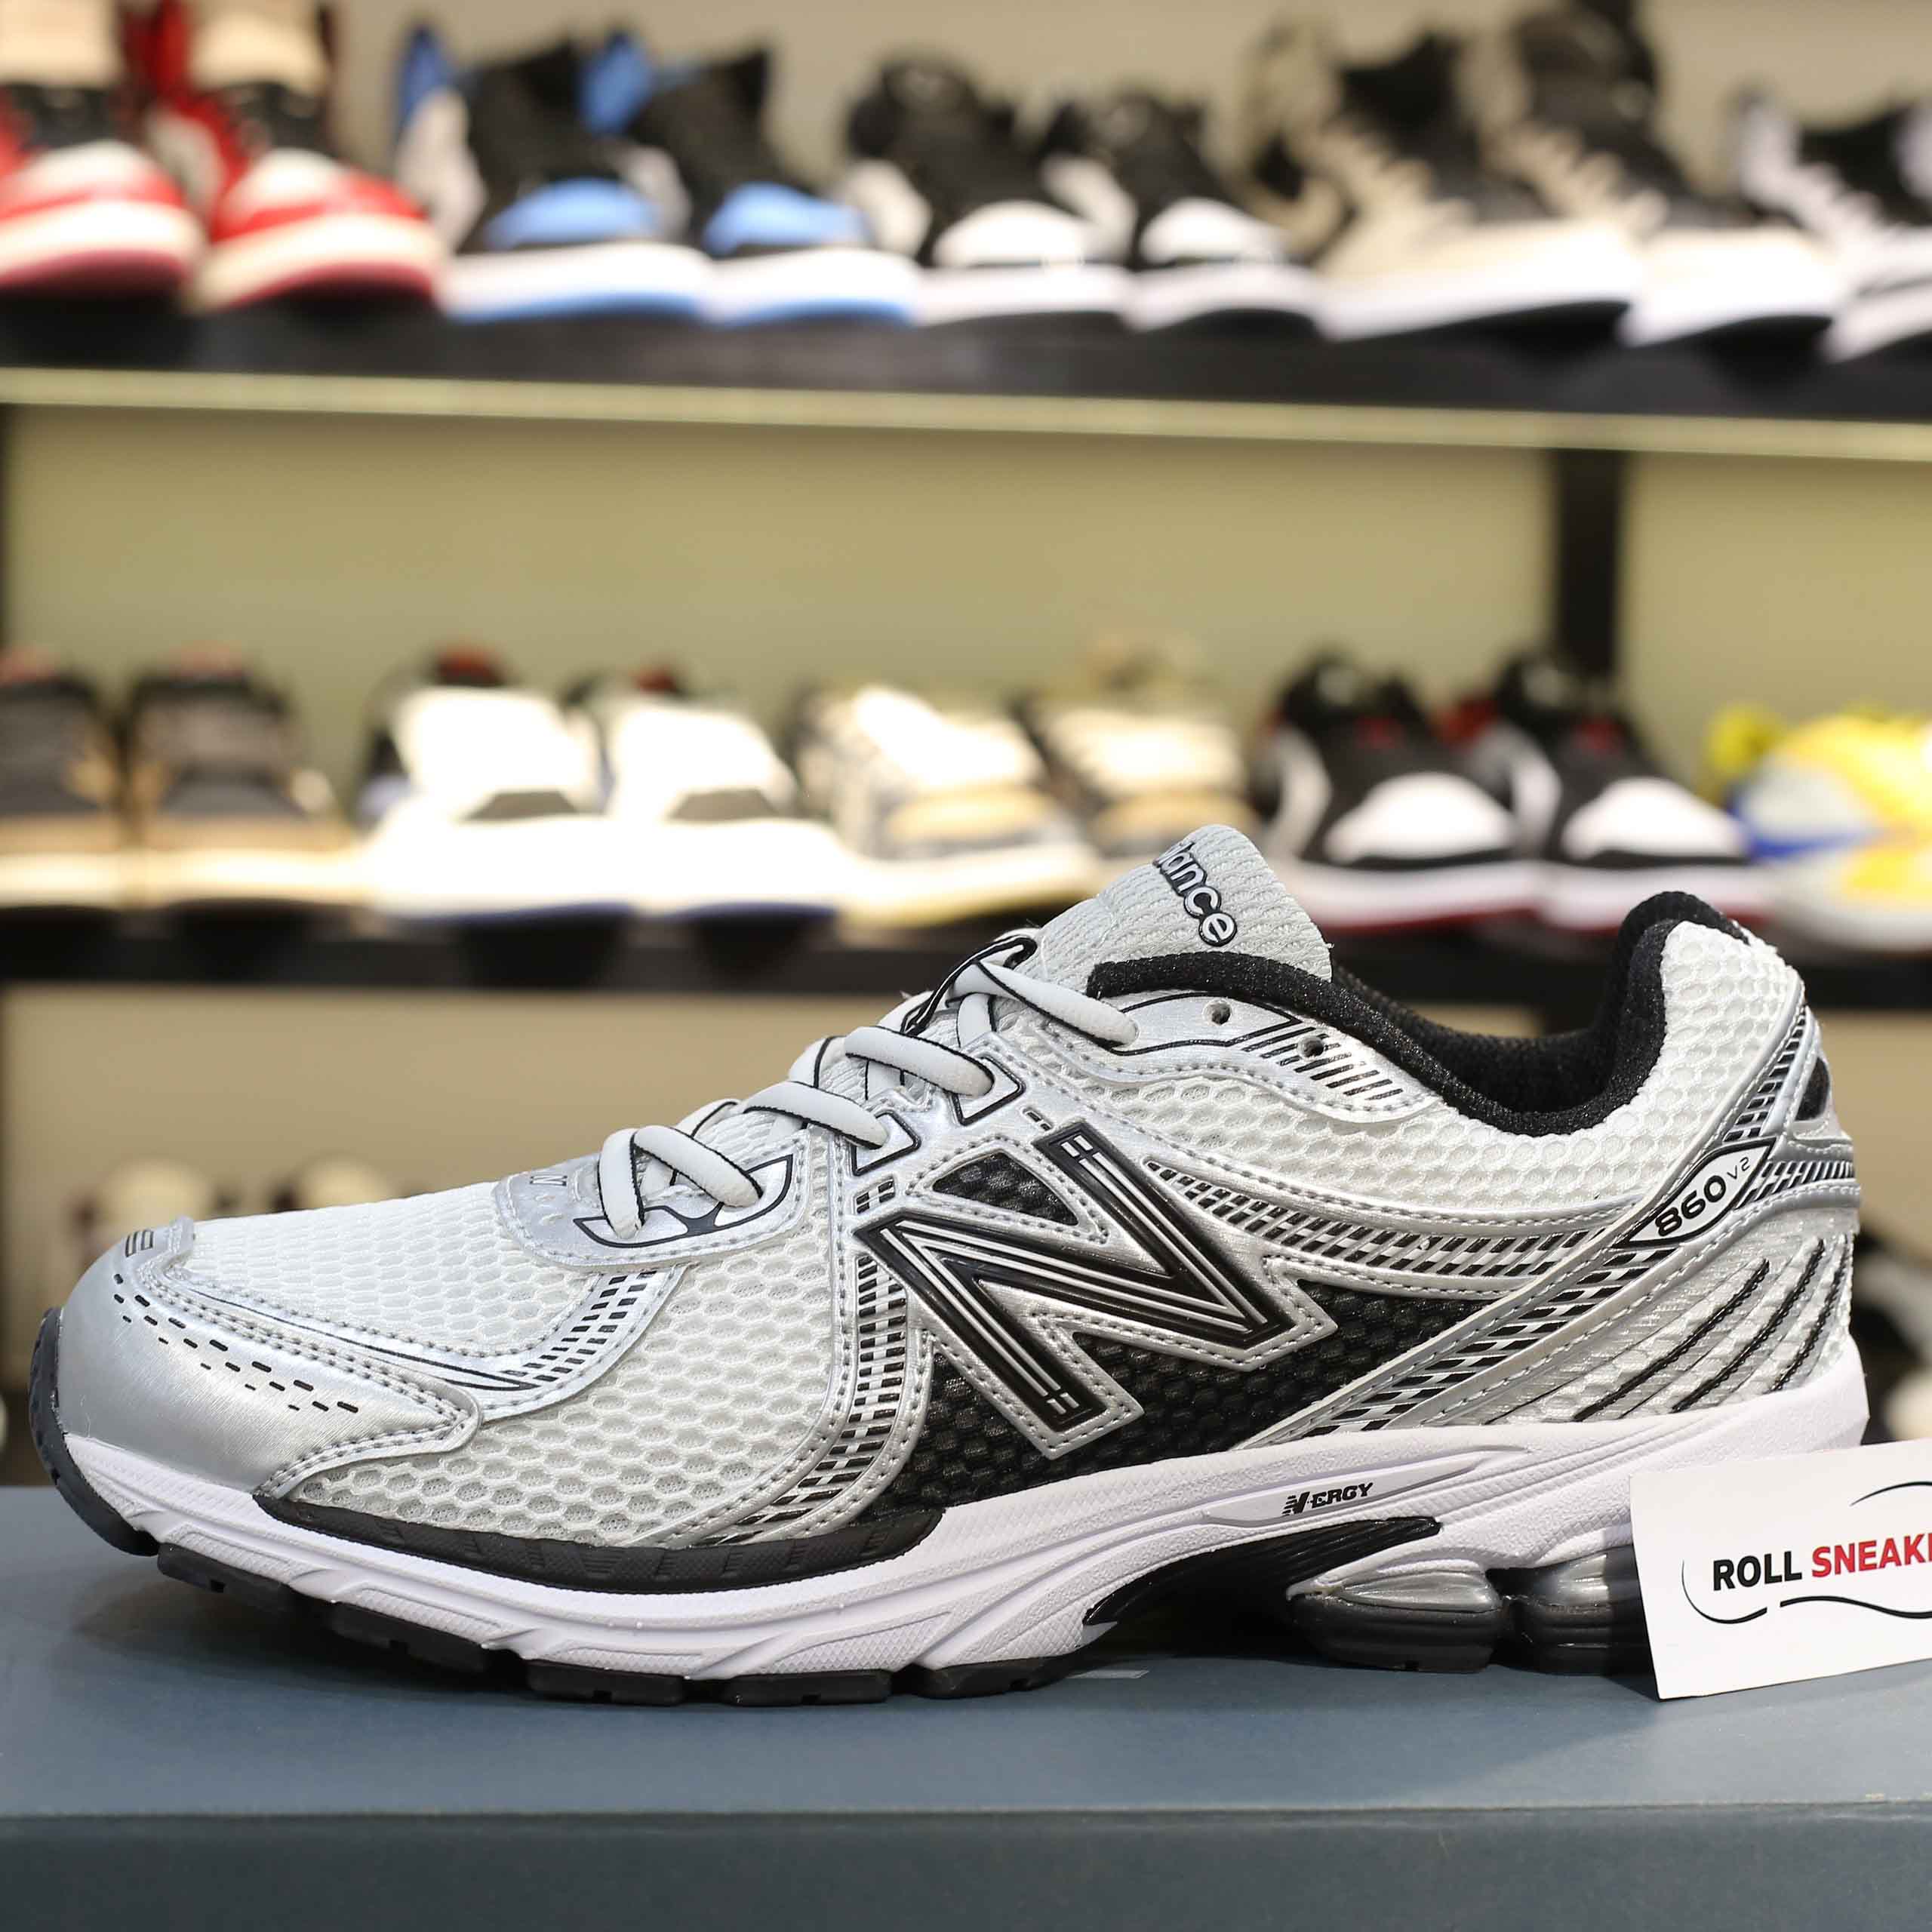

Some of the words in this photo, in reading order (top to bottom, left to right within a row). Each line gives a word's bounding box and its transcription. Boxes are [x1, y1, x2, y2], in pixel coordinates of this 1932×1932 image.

[1153, 841, 1238, 947] lance
[1655, 1175, 1726, 1236] 860
[1713, 1551, 1802, 1591] ROLL
